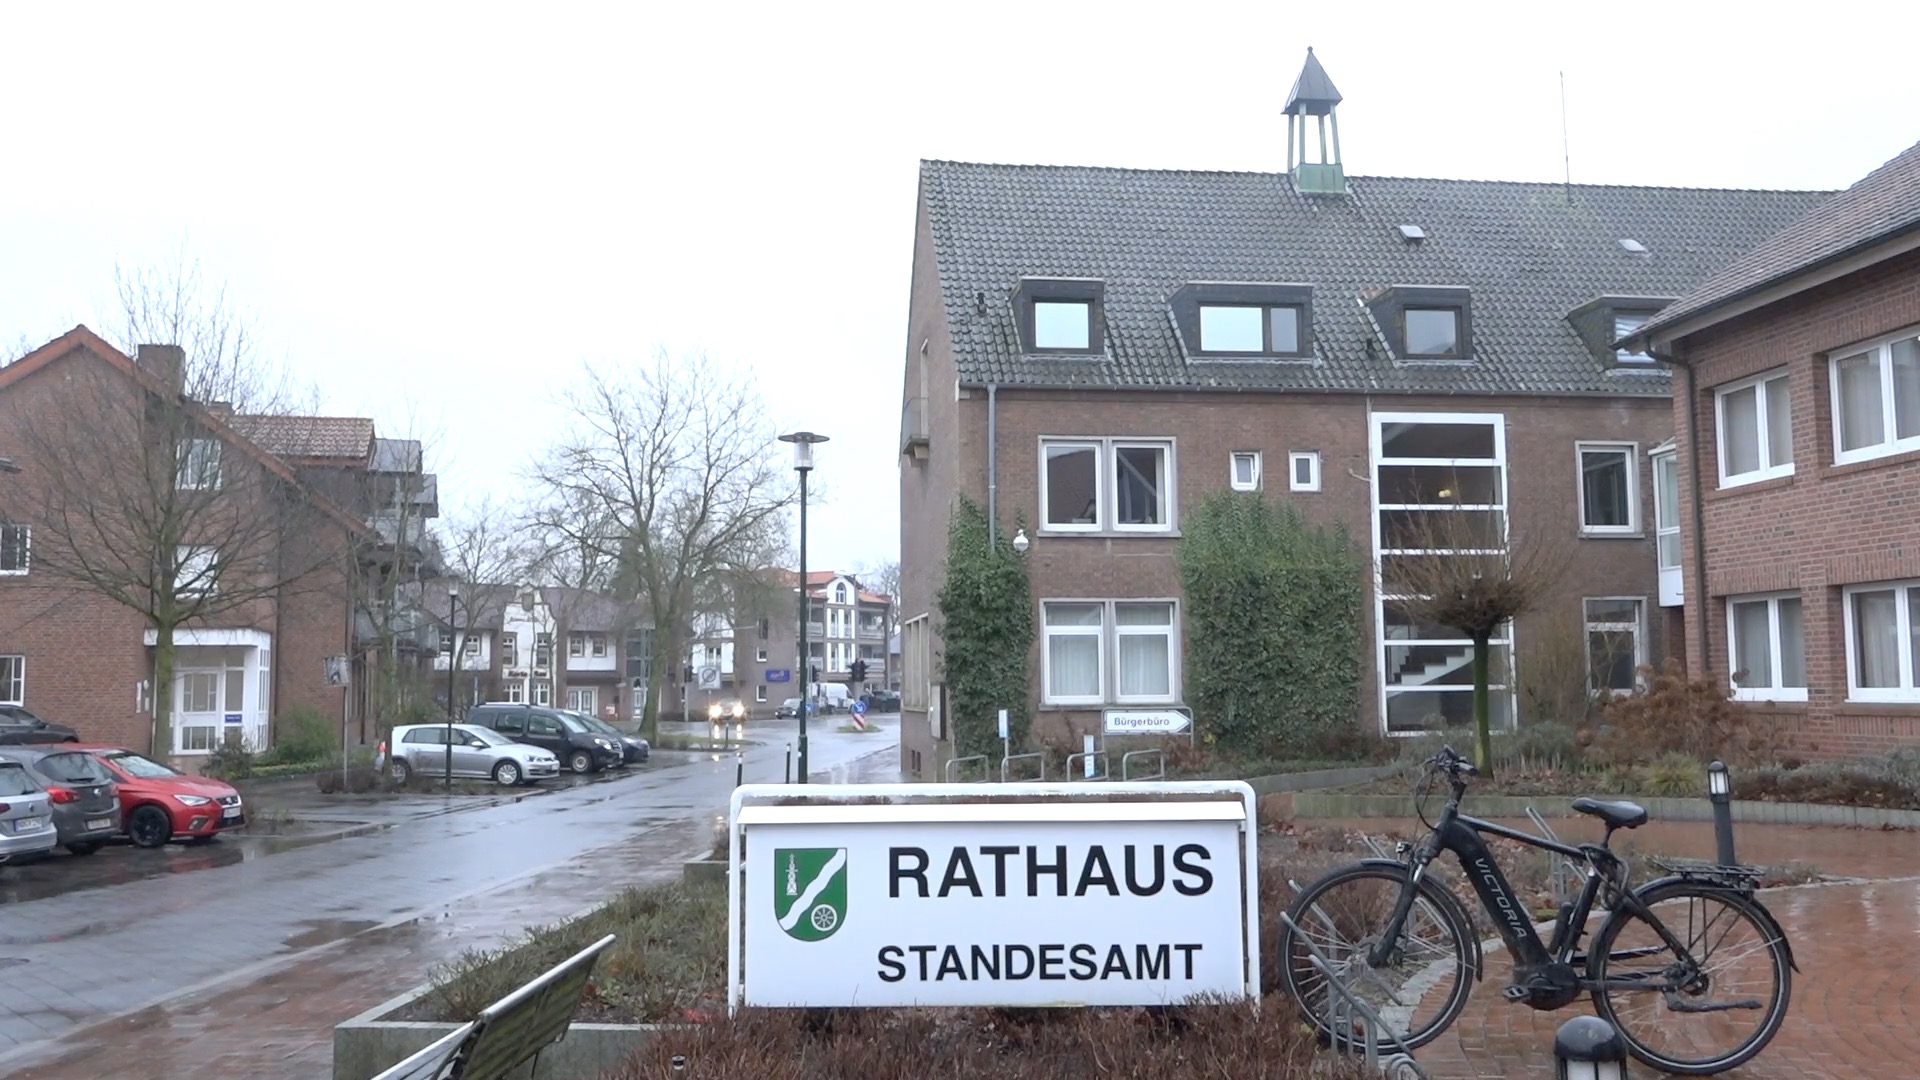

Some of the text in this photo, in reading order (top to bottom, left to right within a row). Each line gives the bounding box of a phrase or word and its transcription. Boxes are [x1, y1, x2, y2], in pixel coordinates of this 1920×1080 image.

[1113, 716, 1170, 728] Bürgerbüro
[889, 843, 1213, 898] RATHAUS
[1475, 857, 1528, 938] VICTORIA
[877, 943, 1203, 983] STANDESAMT
